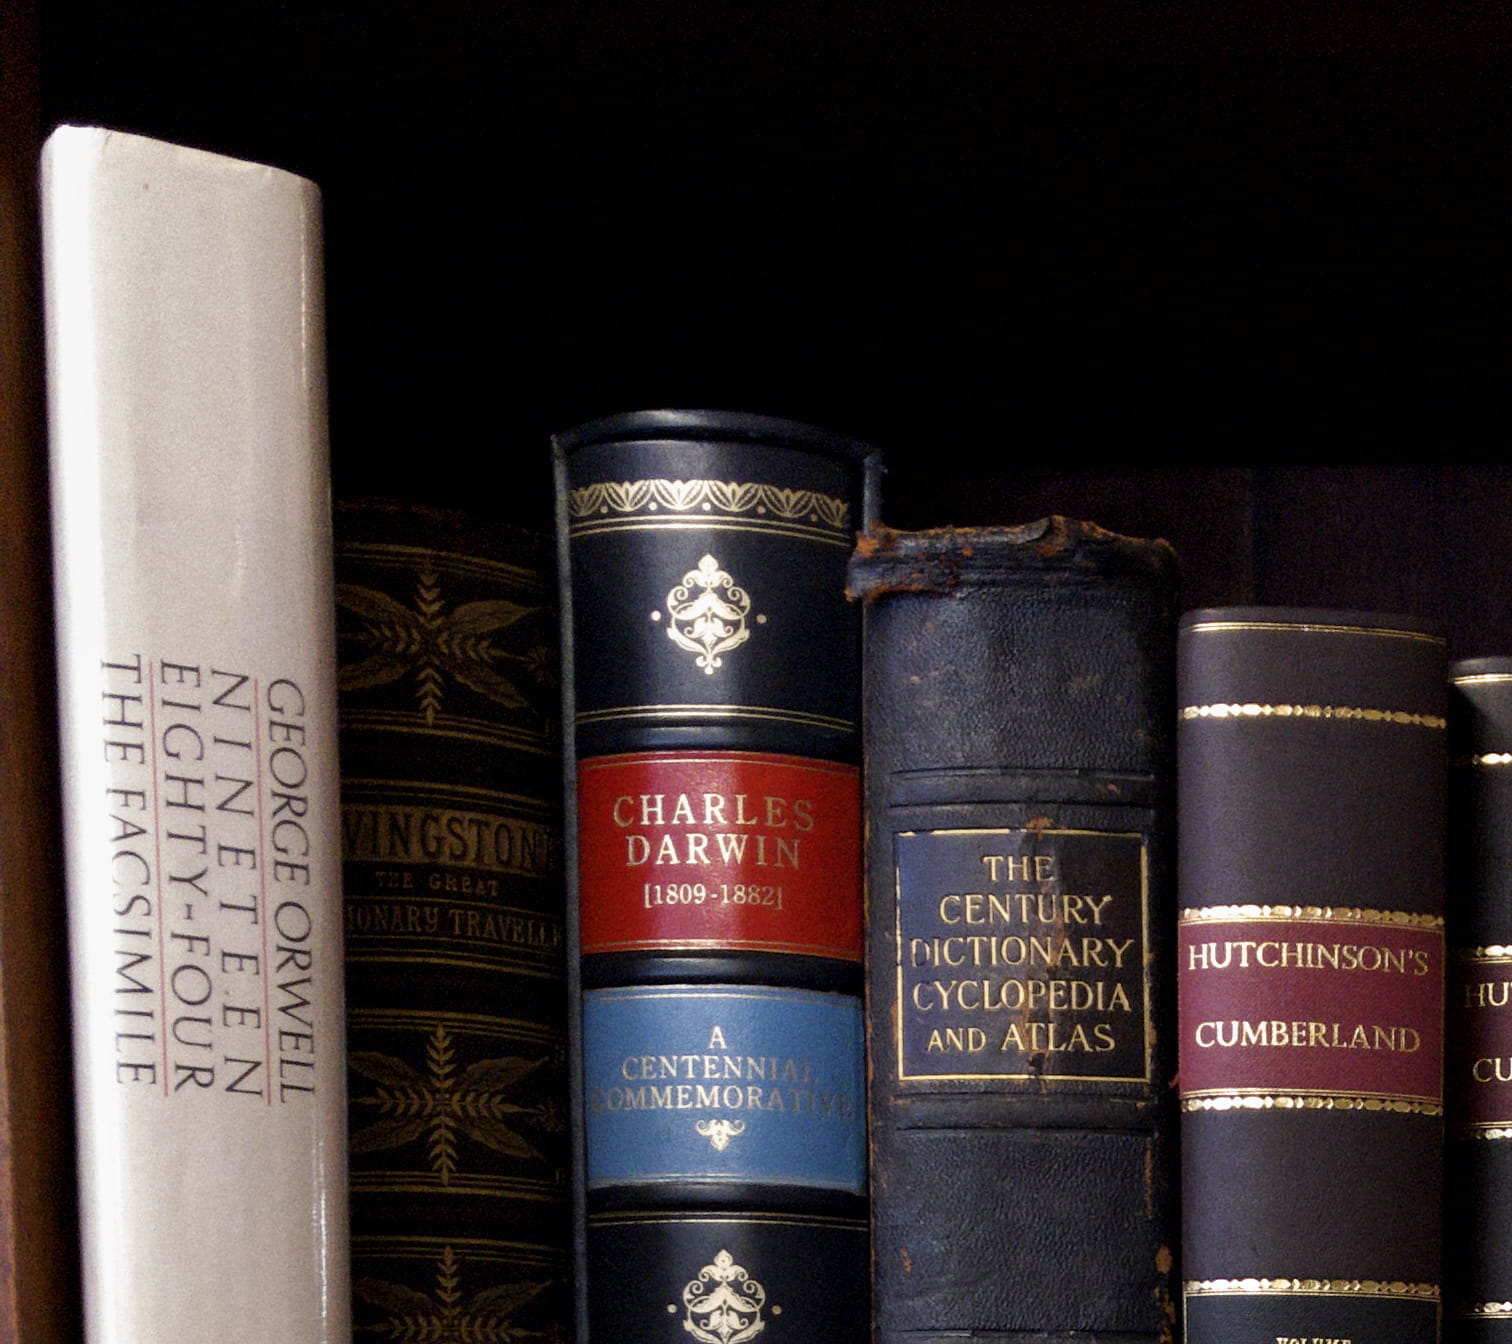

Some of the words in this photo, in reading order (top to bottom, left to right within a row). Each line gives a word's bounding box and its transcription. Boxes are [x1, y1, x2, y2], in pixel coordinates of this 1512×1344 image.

[101, 654, 146, 765] THE
[267, 676, 310, 885] GEORGE
[613, 793, 815, 832] CHARLES
[342, 810, 551, 873] VINGSTON
[625, 833, 802, 870] DARWIN
[160, 657, 216, 1092] EIGHTY-FOUR
[211, 669, 264, 1098] NINETEEN
[375, 871, 414, 889] THE
[983, 855, 1055, 883] THE
[644, 883, 784, 910] [1809-1882]
[939, 894, 1113, 926] CENTURY
[105, 786, 157, 1086] FACSIMILE
[345, 904, 440, 933] IONARY
[909, 935, 1135, 969] DICTIONARY
[1187, 940, 1430, 977] HUTCHINSON'S
[273, 901, 316, 1104] ORWELL
[912, 979, 1133, 1013] CYCLOPEDIA
[709, 1025, 727, 1050] A
[926, 1026, 988, 1053] AND
[1000, 1022, 1117, 1054] ATLAS
[1194, 1019, 1422, 1054] CUMBERLAND
[621, 1055, 817, 1086] CENTENNIAL
[591, 1085, 855, 1122] COMMEMORATIVE
